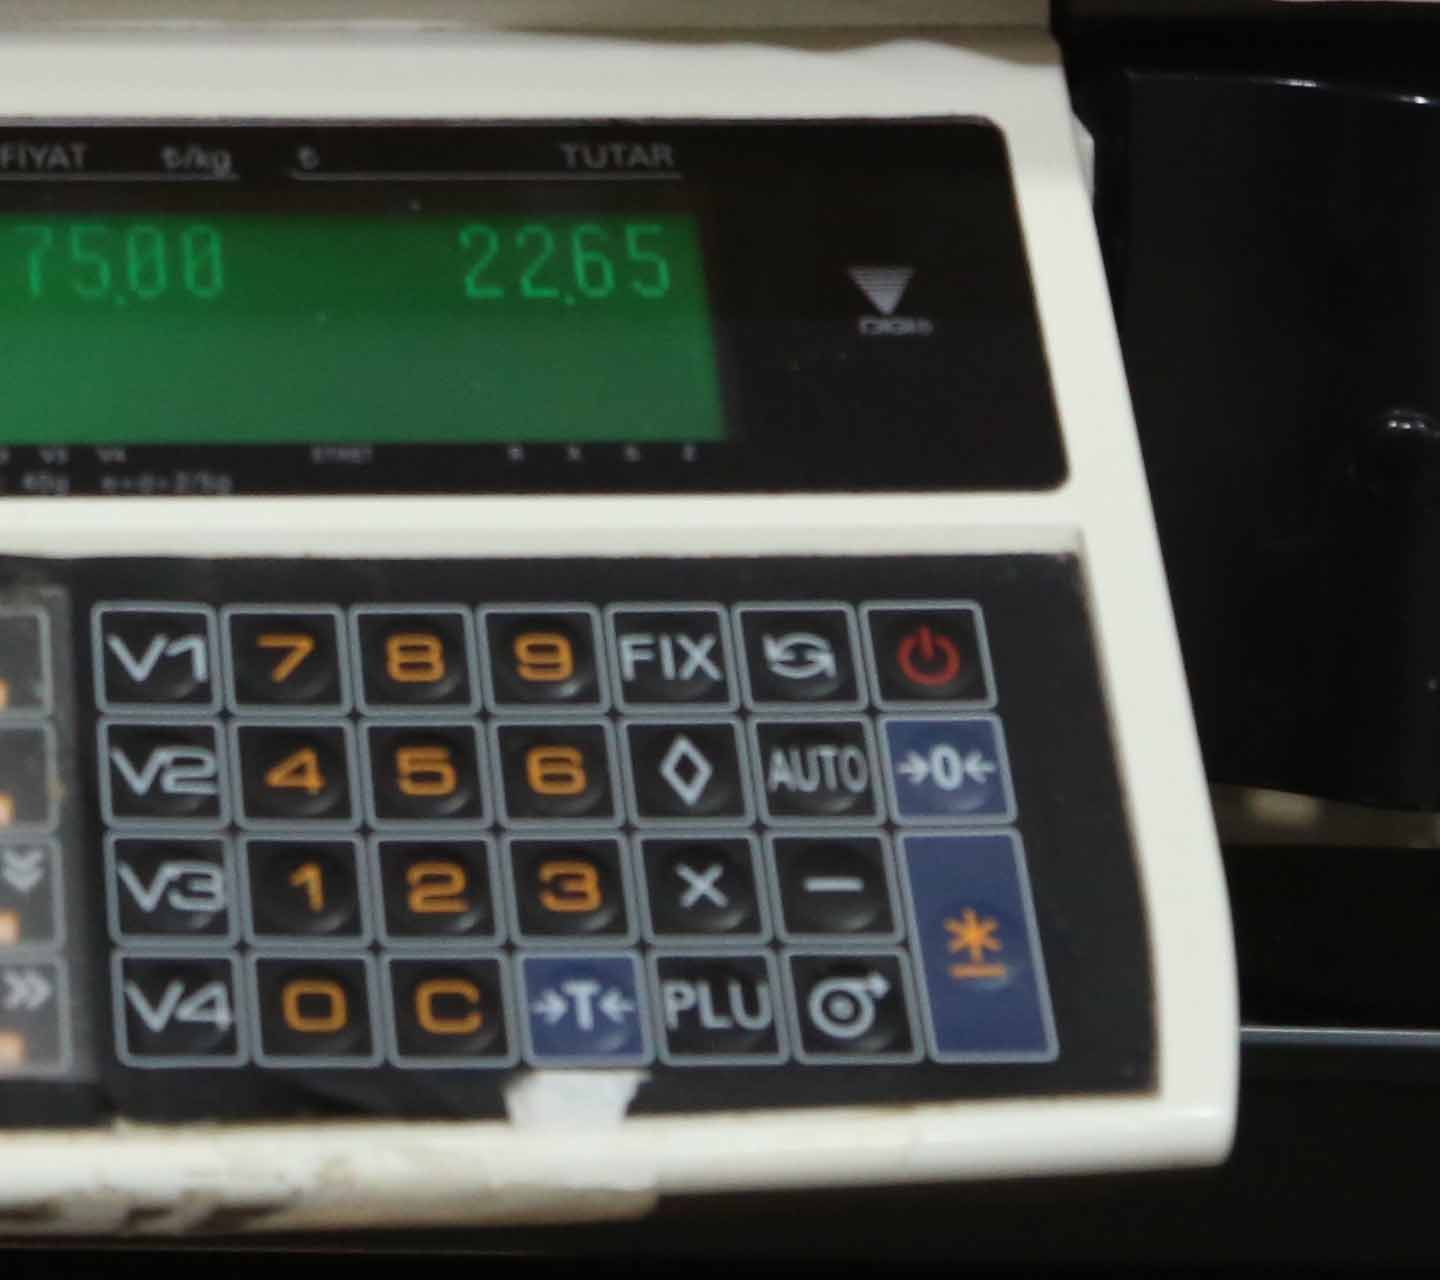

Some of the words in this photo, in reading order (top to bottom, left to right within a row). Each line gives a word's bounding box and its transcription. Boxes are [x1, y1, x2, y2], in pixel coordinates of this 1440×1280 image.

[559, 142, 677, 169] TUTAR
[22, 224, 224, 307] 75.00
[457, 222, 671, 307] 22.65
[110, 635, 208, 683] V1
[256, 636, 317, 682] 7
[384, 635, 445, 682] 8
[513, 635, 573, 682] 9
[620, 634, 722, 682] FIX
[113, 749, 217, 796] V2
[266, 751, 326, 793] 4
[396, 748, 457, 797] 5
[526, 748, 586, 796] 6
[768, 748, 868, 792] AUTO
[121, 863, 225, 912] V3
[290, 864, 324, 911] 1
[406, 864, 469, 912] 2
[538, 864, 602, 912] 3
[127, 981, 232, 1031] V4
[414, 980, 483, 1032] C
[663, 981, 772, 1031] PLU
